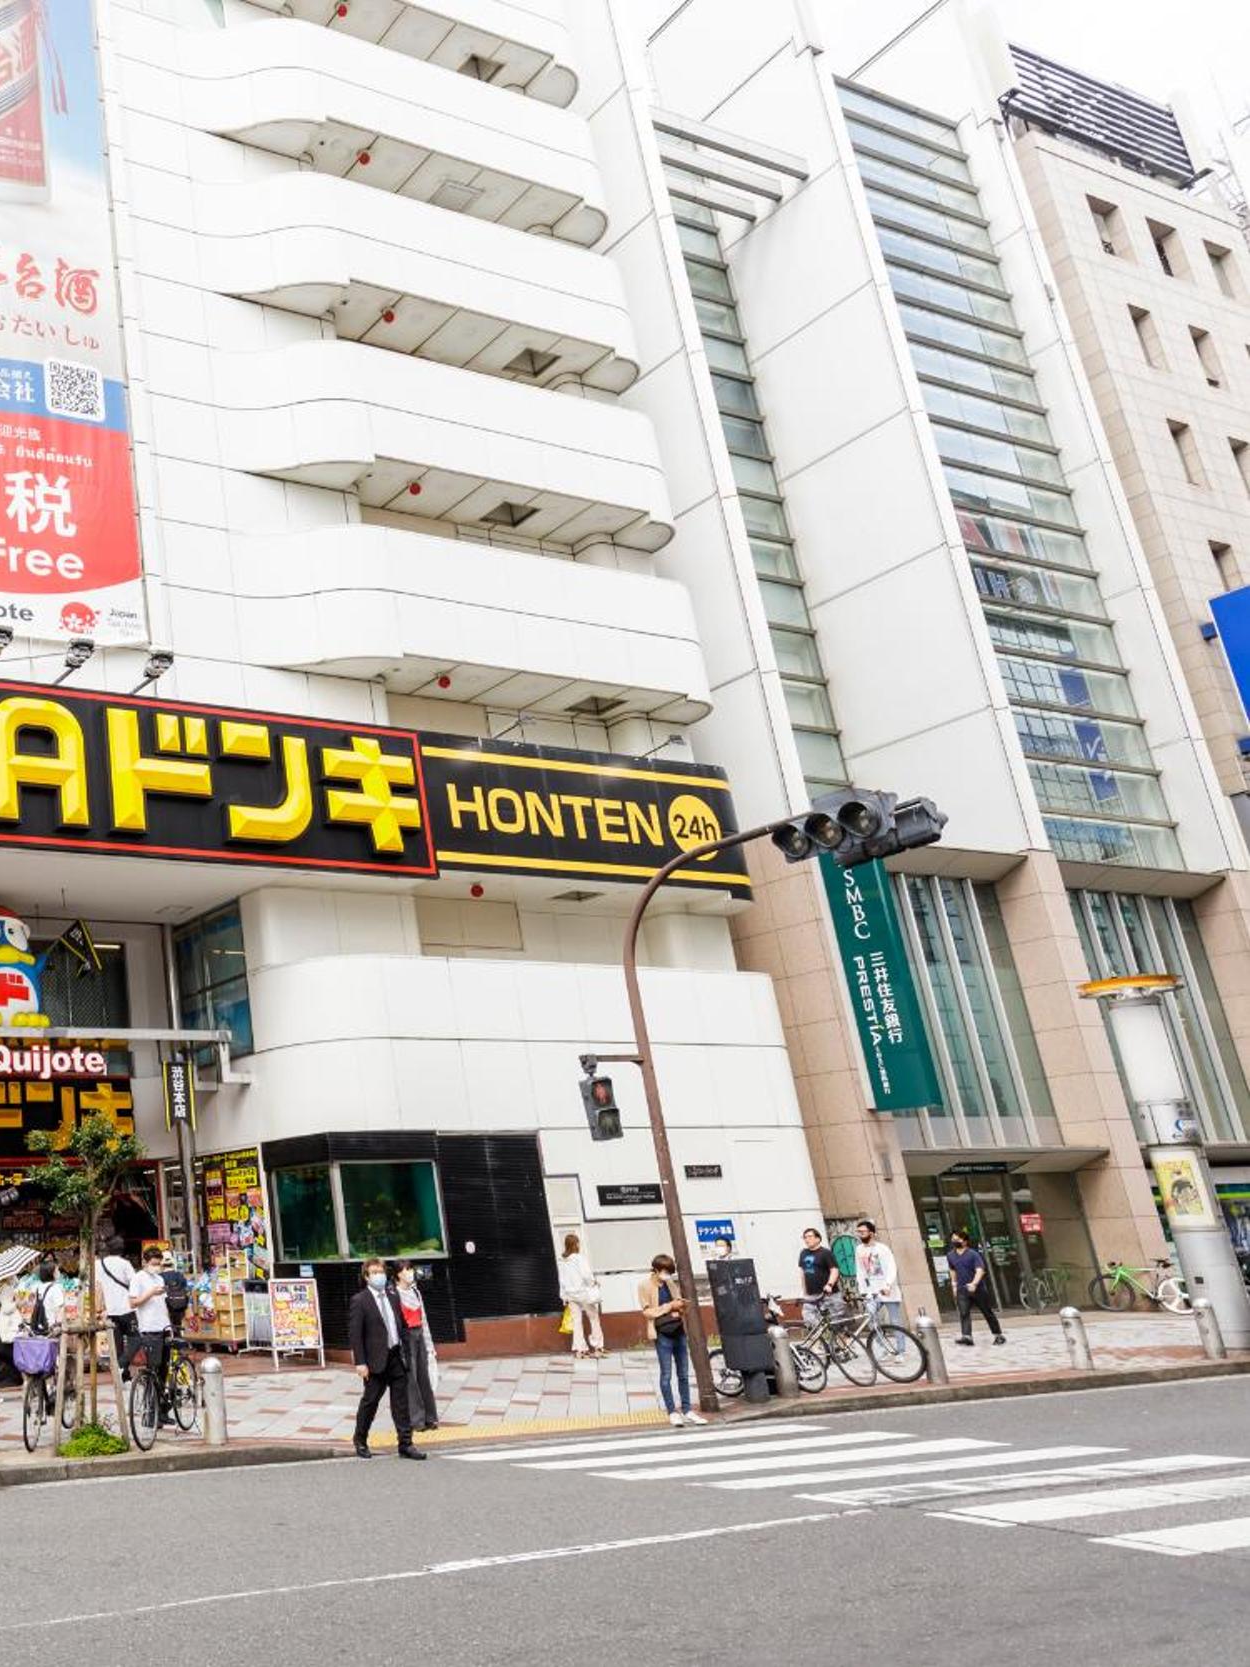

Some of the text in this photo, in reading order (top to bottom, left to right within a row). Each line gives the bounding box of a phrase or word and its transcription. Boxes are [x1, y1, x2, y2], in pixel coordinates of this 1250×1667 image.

[445, 783, 718, 847] HONTEN 24h
[843, 868, 871, 940] SMBC
[870, 951, 903, 1044] 三井住友銀行
[171, 1066, 187, 1118] 渋谷本店
